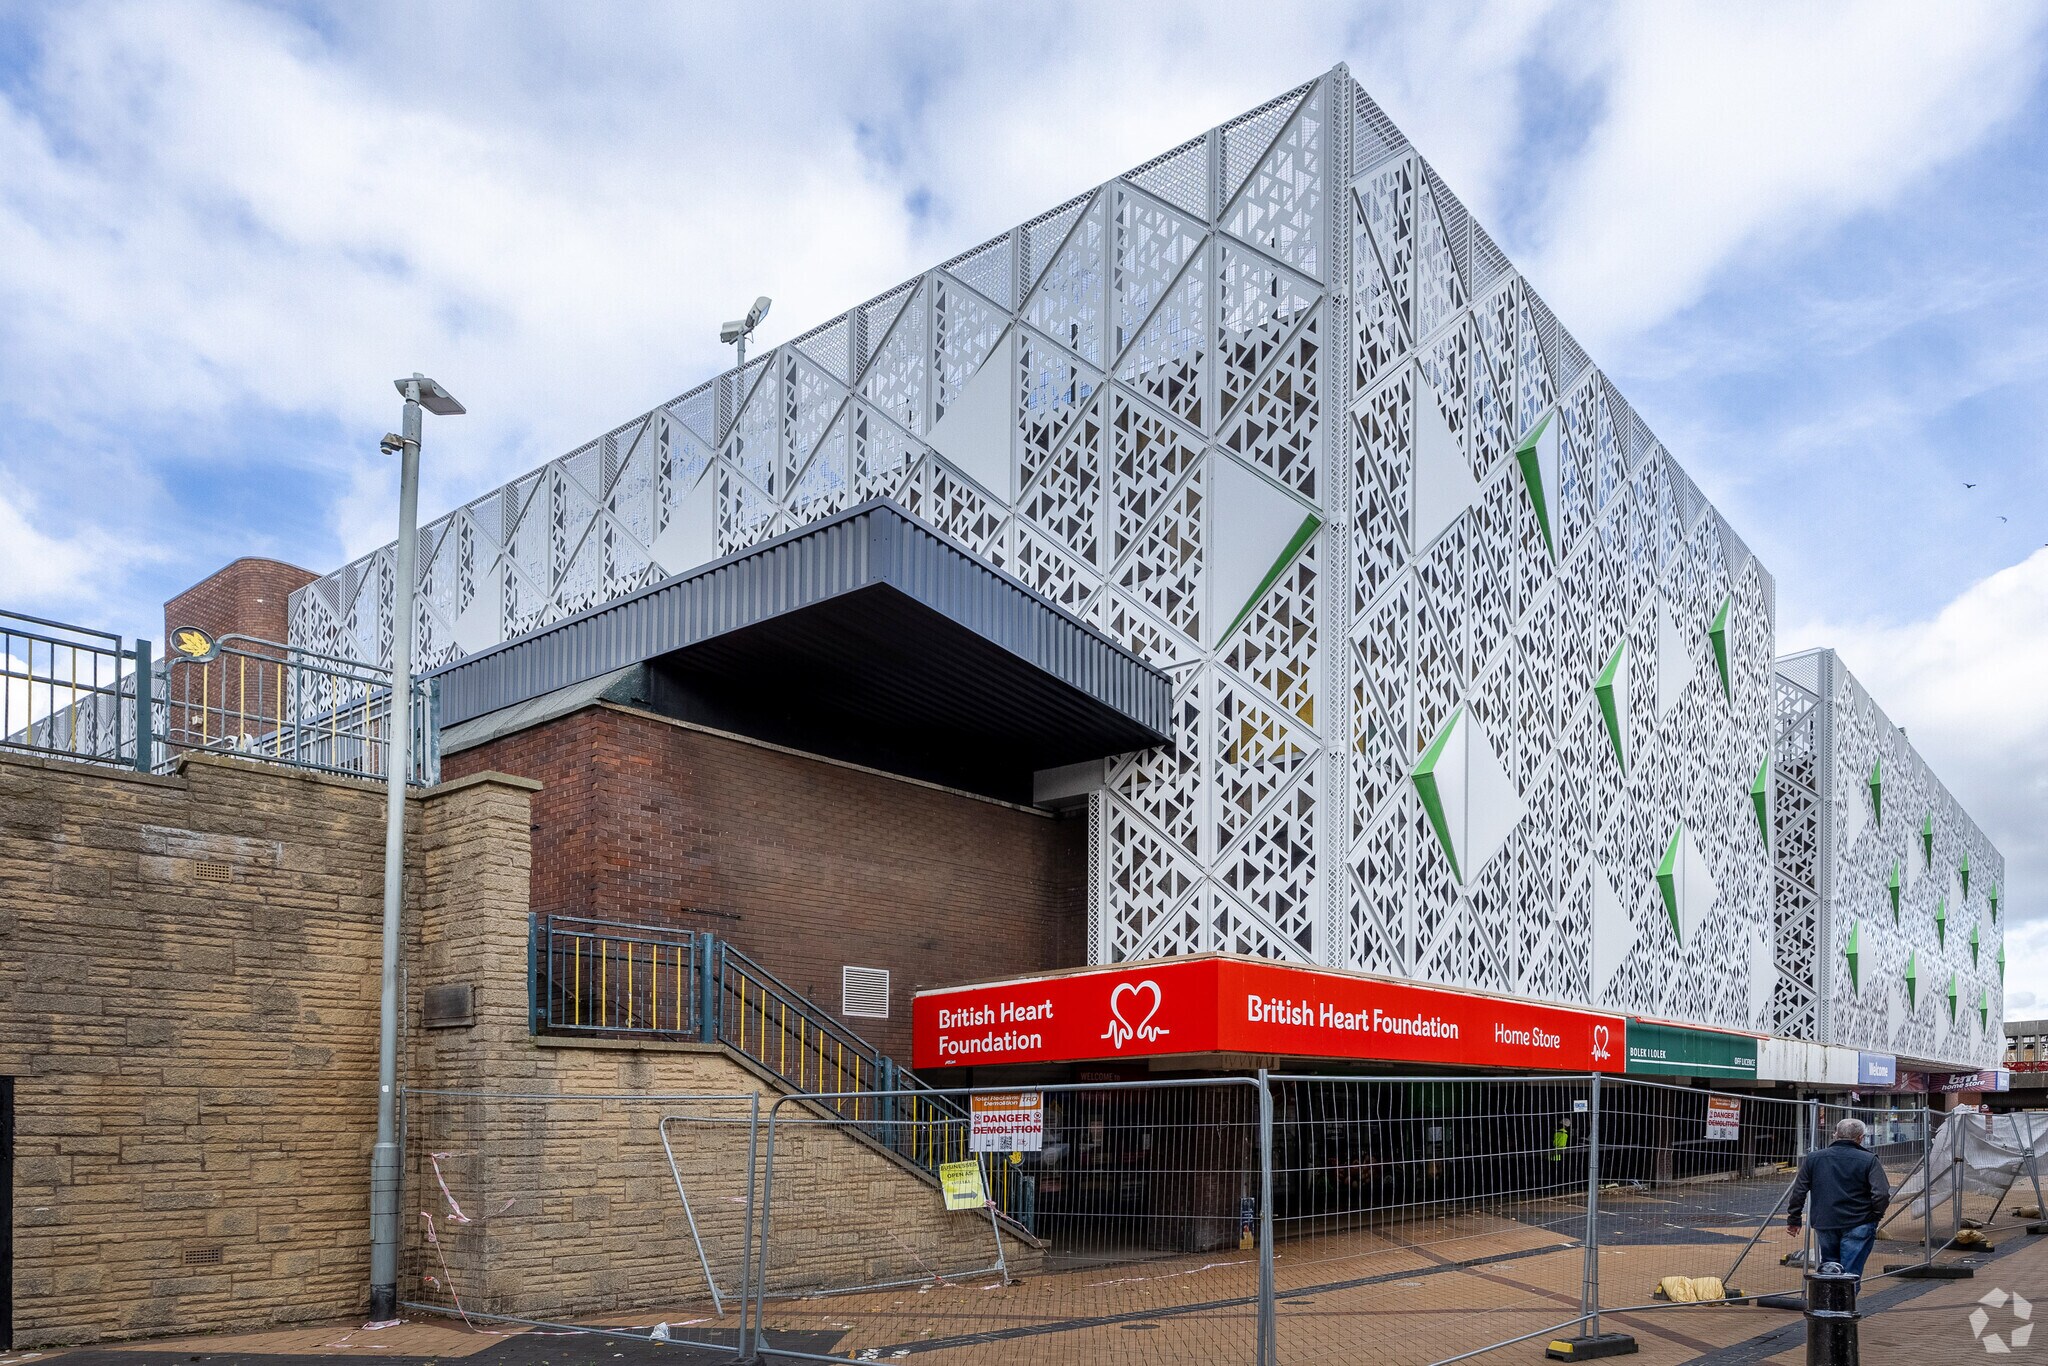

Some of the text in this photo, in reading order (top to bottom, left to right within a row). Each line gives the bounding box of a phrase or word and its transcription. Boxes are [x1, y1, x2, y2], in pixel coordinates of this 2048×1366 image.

[938, 999, 1054, 1029] British Heart
[1247, 994, 1459, 1039] British Heart Foundation
[1495, 1022, 1560, 1049] Home Store
[939, 1031, 1042, 1055] Foundation
[1630, 1047, 1647, 1058] BOLEK
[1650, 1048, 1666, 1059] LOLEK
[1734, 1057, 1756, 1067] OFF LICENCE
[1868, 1061, 1889, 1077] Welcome
[1080, 1072, 1113, 1081] WELCOME
[1941, 1080, 1986, 1091] home store
[983, 1113, 1030, 1123] DANGER
[1713, 1111, 1734, 1119] DANGER
[1708, 1119, 1739, 1127] DEMOLITION
[973, 1125, 1041, 1135] DEMOLITION
[940, 1161, 977, 1171] BUSINESSES
